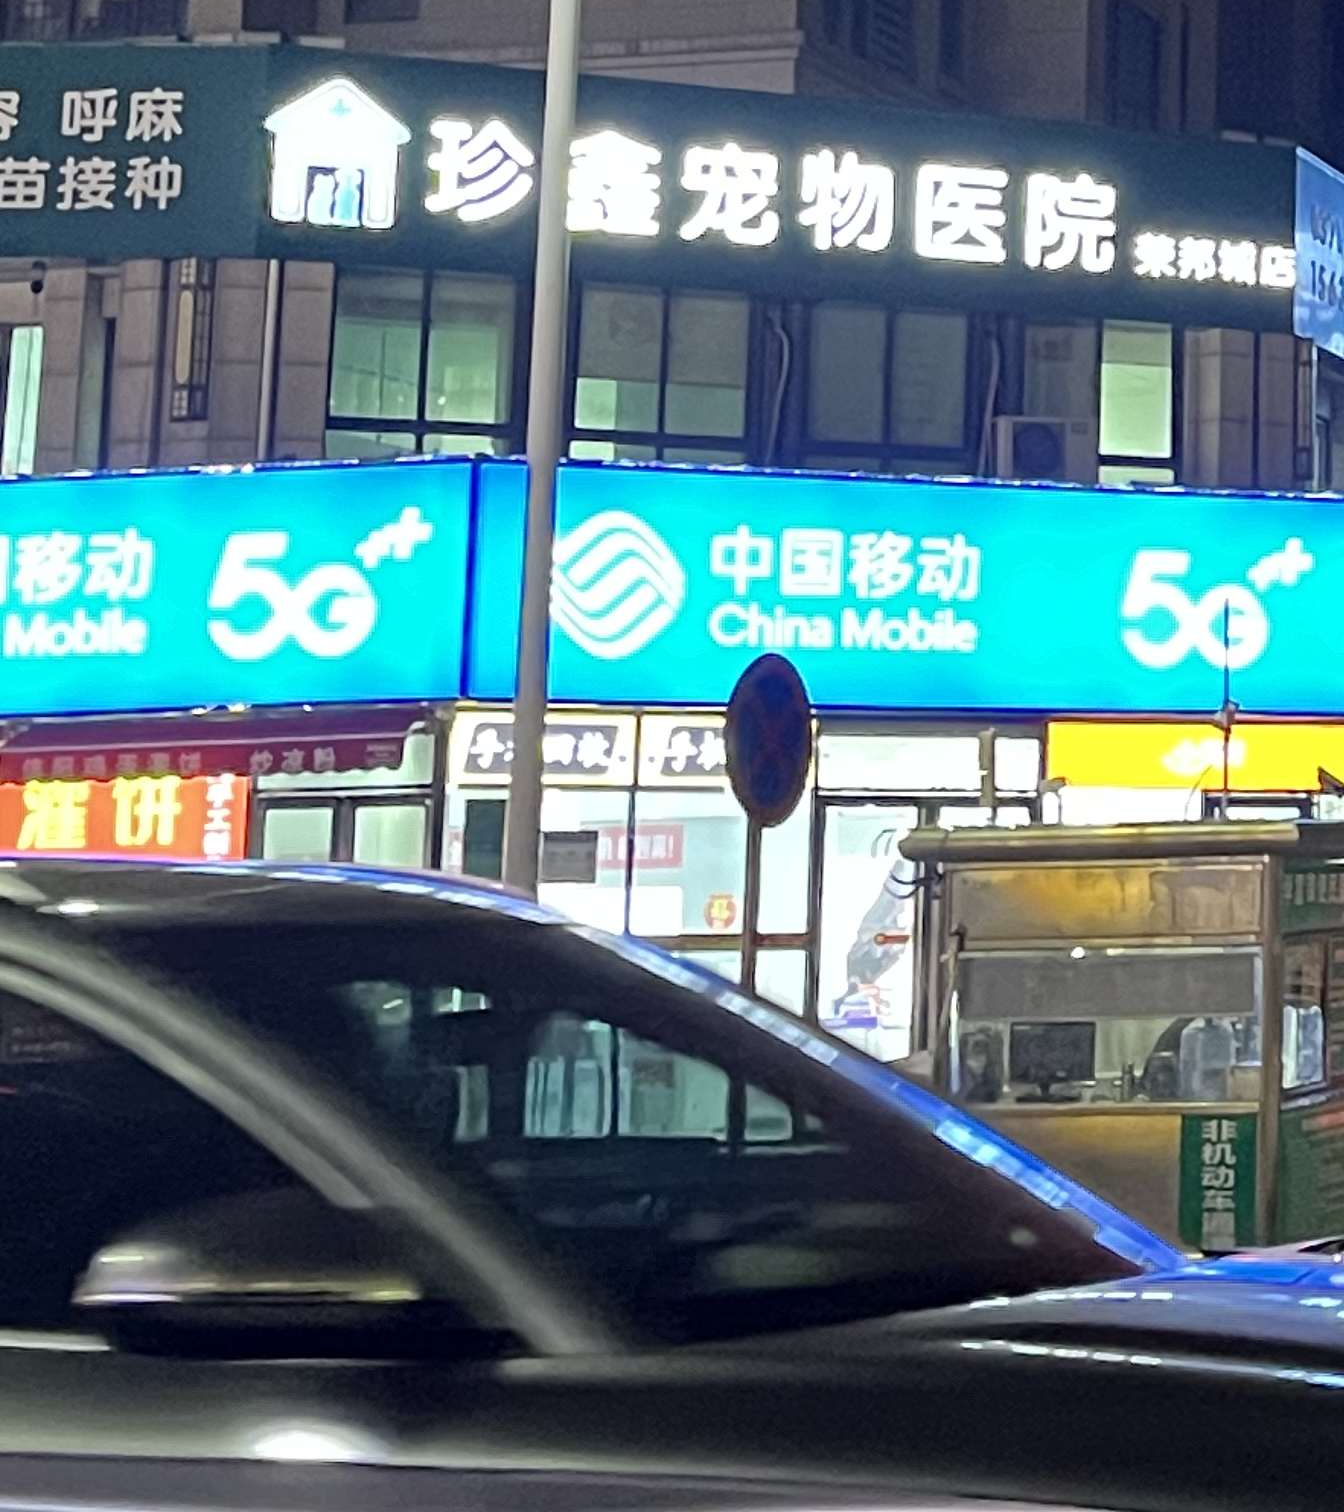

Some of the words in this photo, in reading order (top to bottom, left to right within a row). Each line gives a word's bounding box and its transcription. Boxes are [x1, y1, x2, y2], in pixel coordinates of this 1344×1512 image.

[61, 87, 184, 143] 呼麻
[0, 155, 183, 211] 苗接种
[424, 117, 1117, 273] 珍鑫宠物医院
[0, 526, 155, 604] 移动
[711, 524, 981, 601] 中国移动
[3, 606, 147, 659] Mobile
[709, 602, 833, 651] China
[841, 606, 977, 653] Mobile
[470, 727, 613, 771] 手回收
